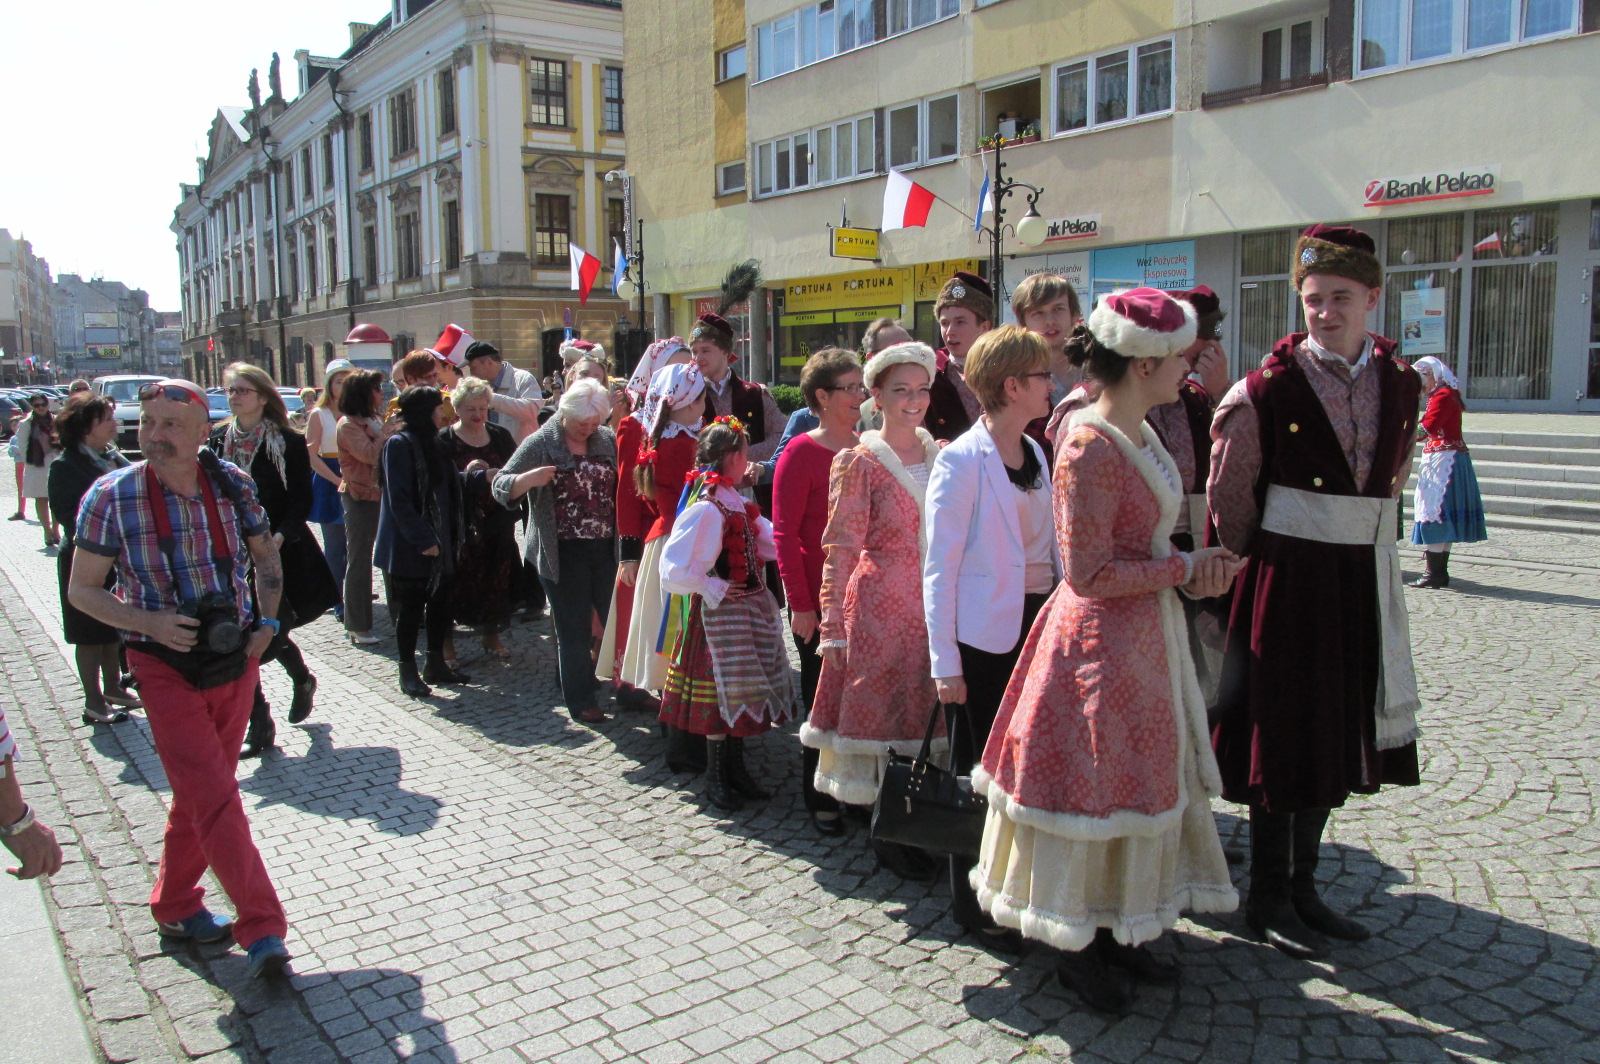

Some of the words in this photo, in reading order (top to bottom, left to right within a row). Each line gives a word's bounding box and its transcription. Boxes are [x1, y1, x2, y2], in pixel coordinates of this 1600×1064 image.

[1386, 176, 1433, 199] Bank
[1435, 171, 1494, 194] Pekao
[1062, 218, 1097, 235] Pekao
[837, 236, 875, 246] FORTUNA
[789, 282, 832, 296] FORTUNA
[843, 276, 894, 291] FORTUNA
